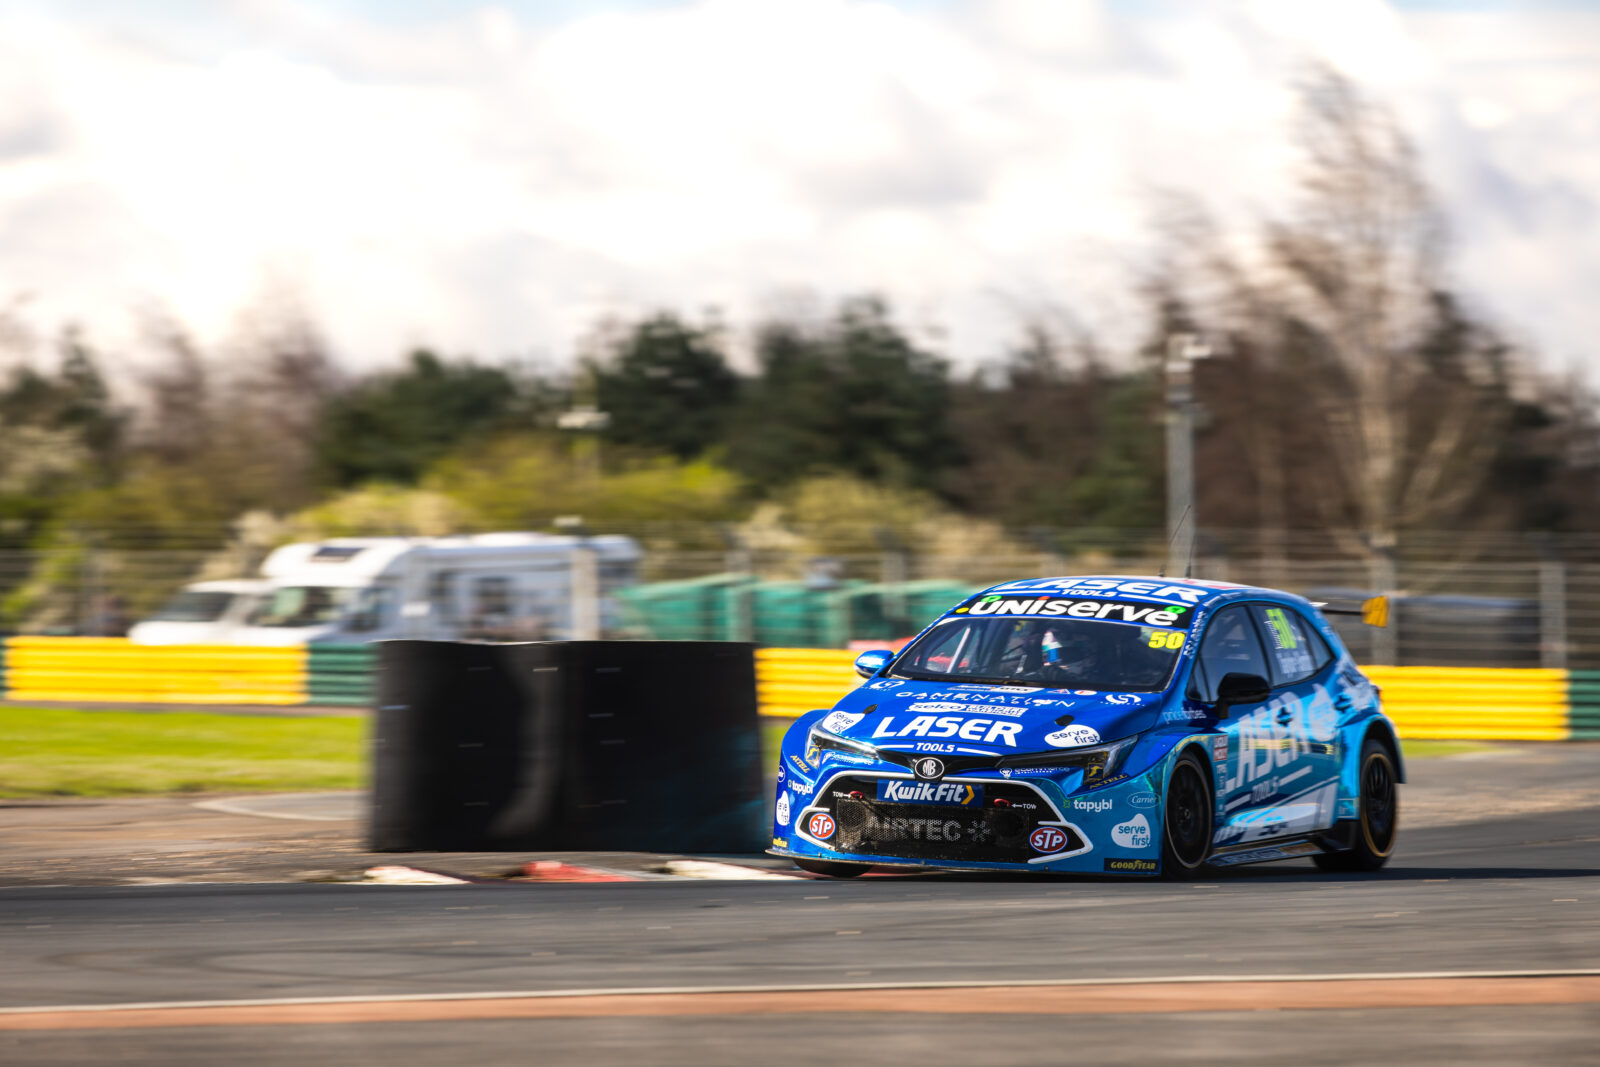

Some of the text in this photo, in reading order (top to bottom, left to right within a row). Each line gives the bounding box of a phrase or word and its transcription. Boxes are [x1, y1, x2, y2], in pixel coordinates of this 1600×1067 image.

[993, 578, 1209, 603] LASER
[1062, 589, 1117, 598] TOOLS
[1148, 632, 1185, 649] 50
[872, 716, 1023, 747] LASER
[1052, 728, 1089, 740] serve
[916, 742, 955, 753] TOOLS
[1225, 691, 1312, 794] ASER
[792, 781, 814, 795] tapybl
[1074, 799, 1112, 813] tapybl
[811, 815, 832, 836] STP
[1118, 825, 1147, 834] serve
[1034, 829, 1064, 850] STP
[1110, 860, 1156, 870] GOODYEAR
